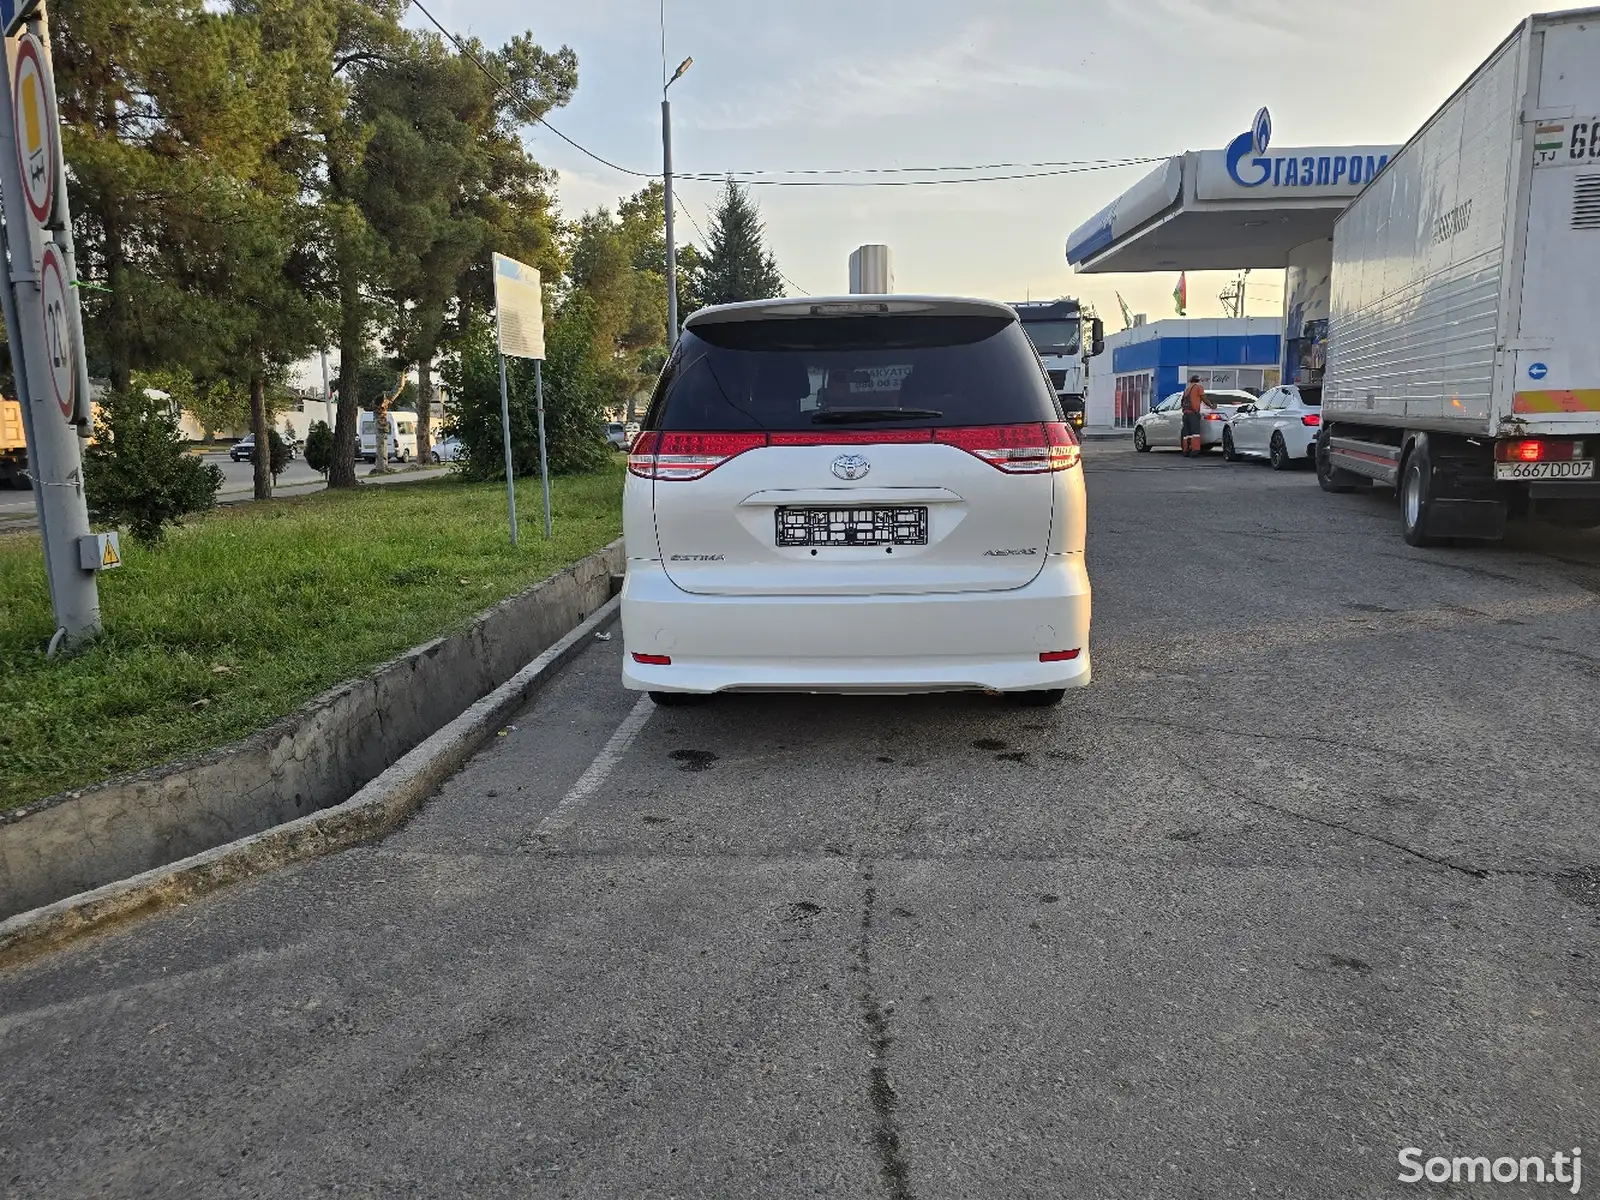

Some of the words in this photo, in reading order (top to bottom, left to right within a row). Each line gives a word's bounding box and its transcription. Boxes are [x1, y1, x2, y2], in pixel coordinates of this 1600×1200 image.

[1540, 151, 1556, 162] TJ
[1273, 155, 1389, 187] ГАЗПРОМ
[47, 300, 67, 368] 20
[1513, 462, 1591, 477] 6667DD07
